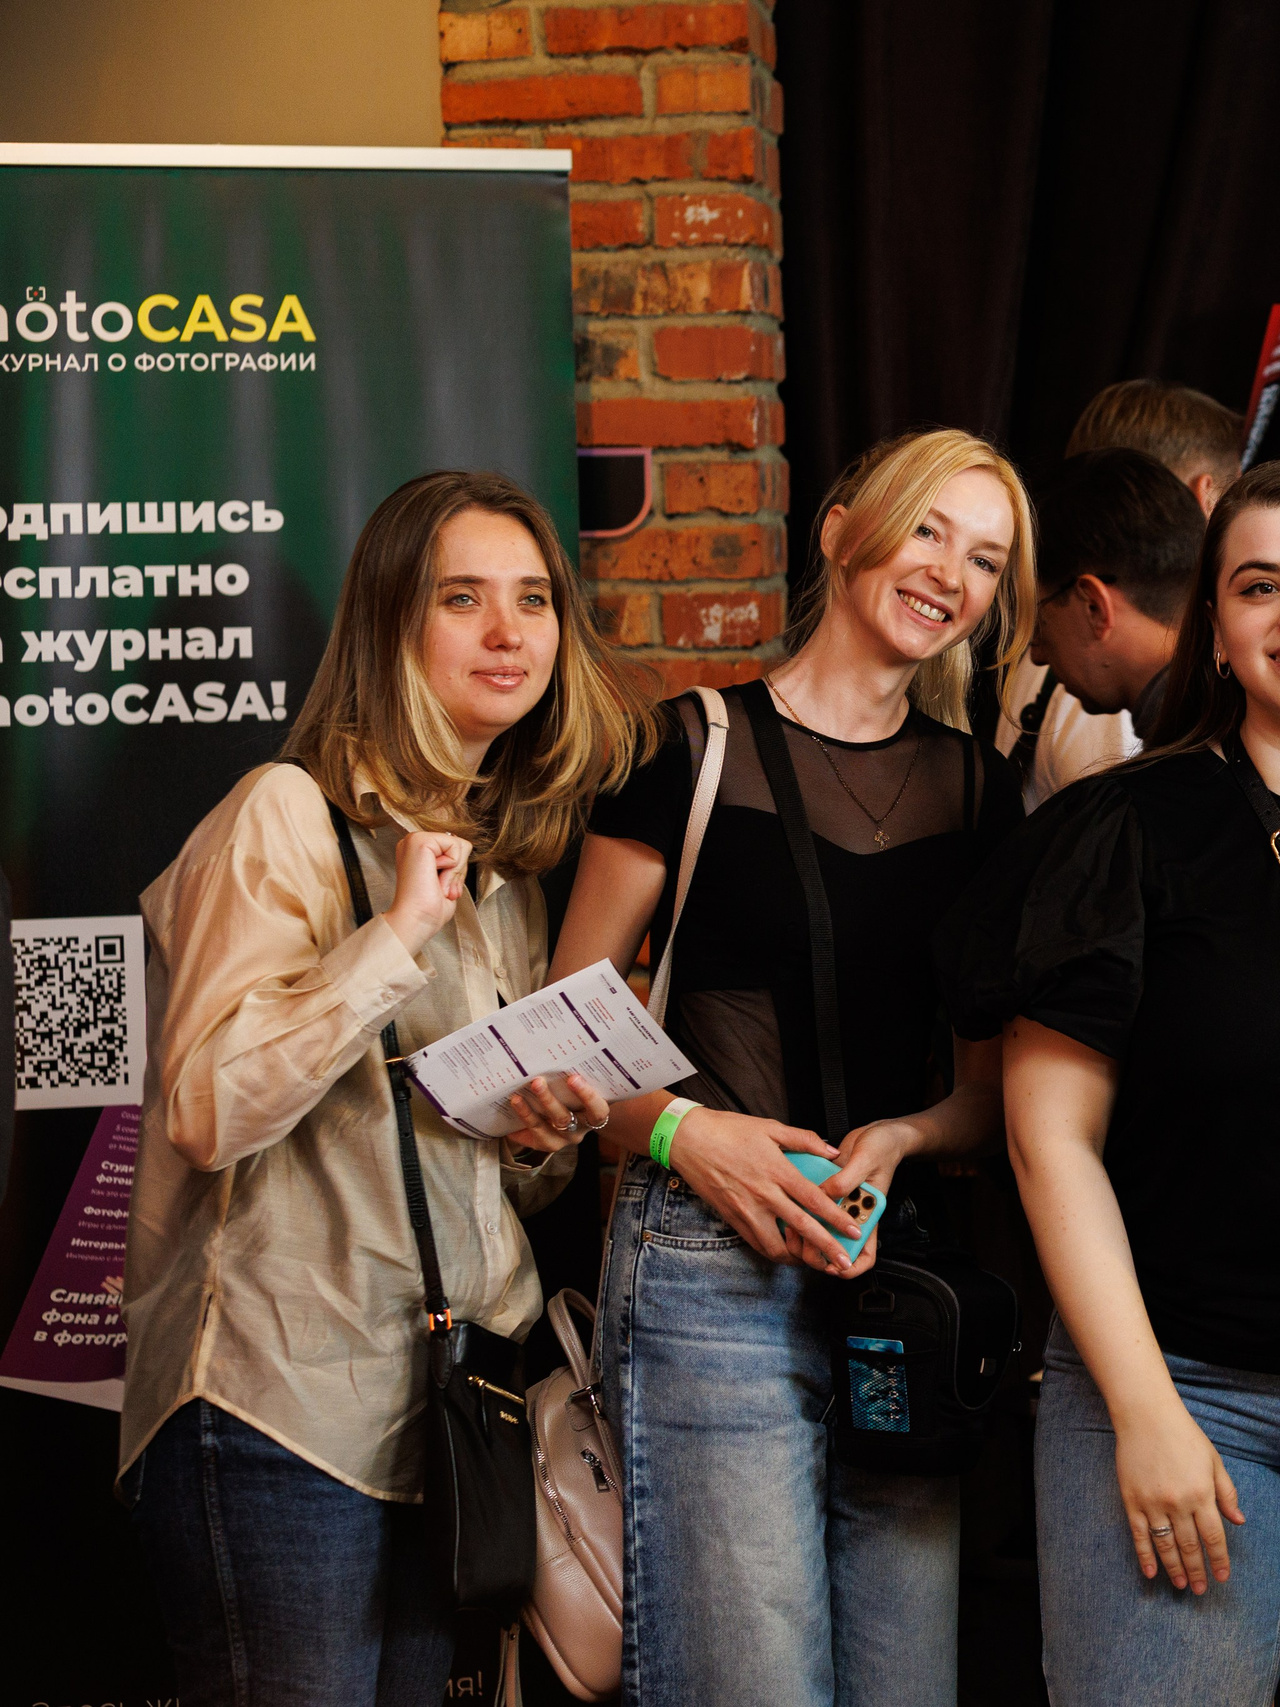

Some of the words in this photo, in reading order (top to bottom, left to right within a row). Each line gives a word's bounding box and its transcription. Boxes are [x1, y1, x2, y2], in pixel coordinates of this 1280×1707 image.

[0, 288, 317, 343] otoCASA
[106, 352, 127, 372] О
[134, 351, 316, 373] ФОТОГРАФИИ
[0, 500, 285, 541] дпишись
[0, 563, 250, 600] сплатно
[20, 626, 253, 672] журнал
[42, 1308, 100, 1326] фона
[104, 1313, 119, 1325] и
[33, 1330, 48, 1341] в
[53, 1329, 128, 1348] фотогр
